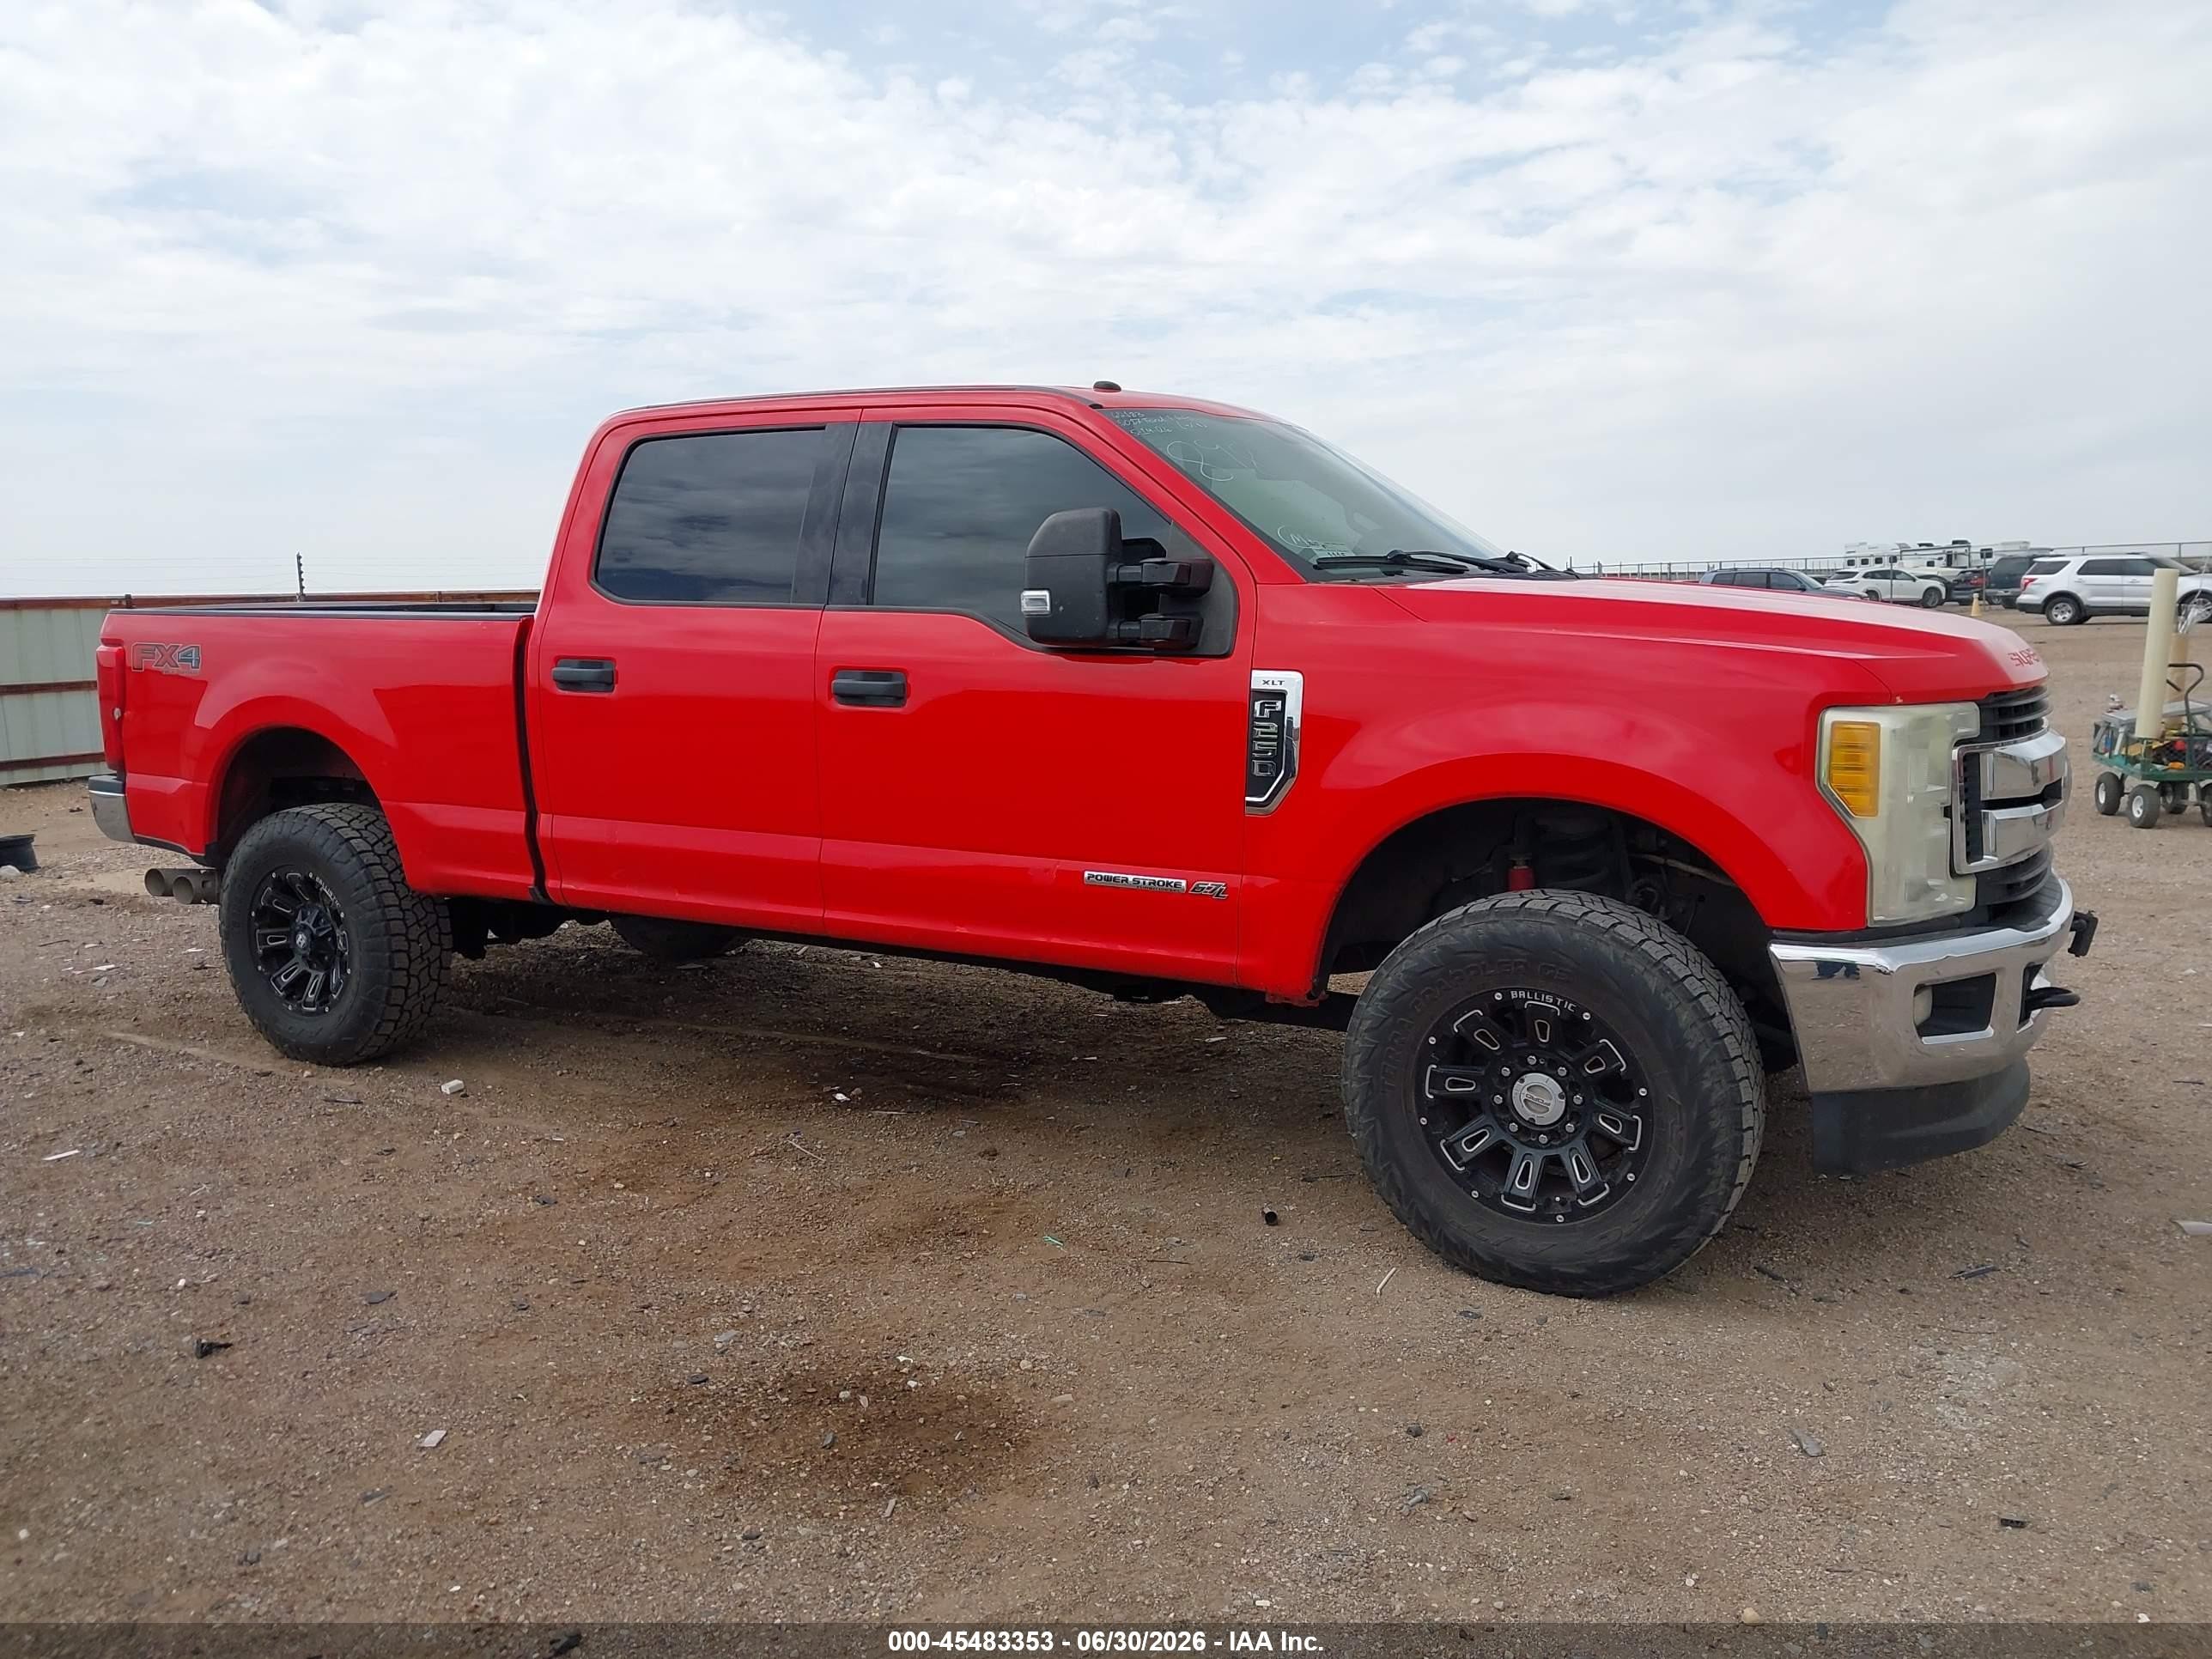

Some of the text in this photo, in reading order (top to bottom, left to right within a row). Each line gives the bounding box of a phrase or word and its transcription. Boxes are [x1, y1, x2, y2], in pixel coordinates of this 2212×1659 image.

[131, 642, 202, 672] FX4
[1087, 873, 1129, 884] POWER
[1132, 877, 1182, 889] STROKE
[1510, 990, 1577, 1012] BALLISTIC
